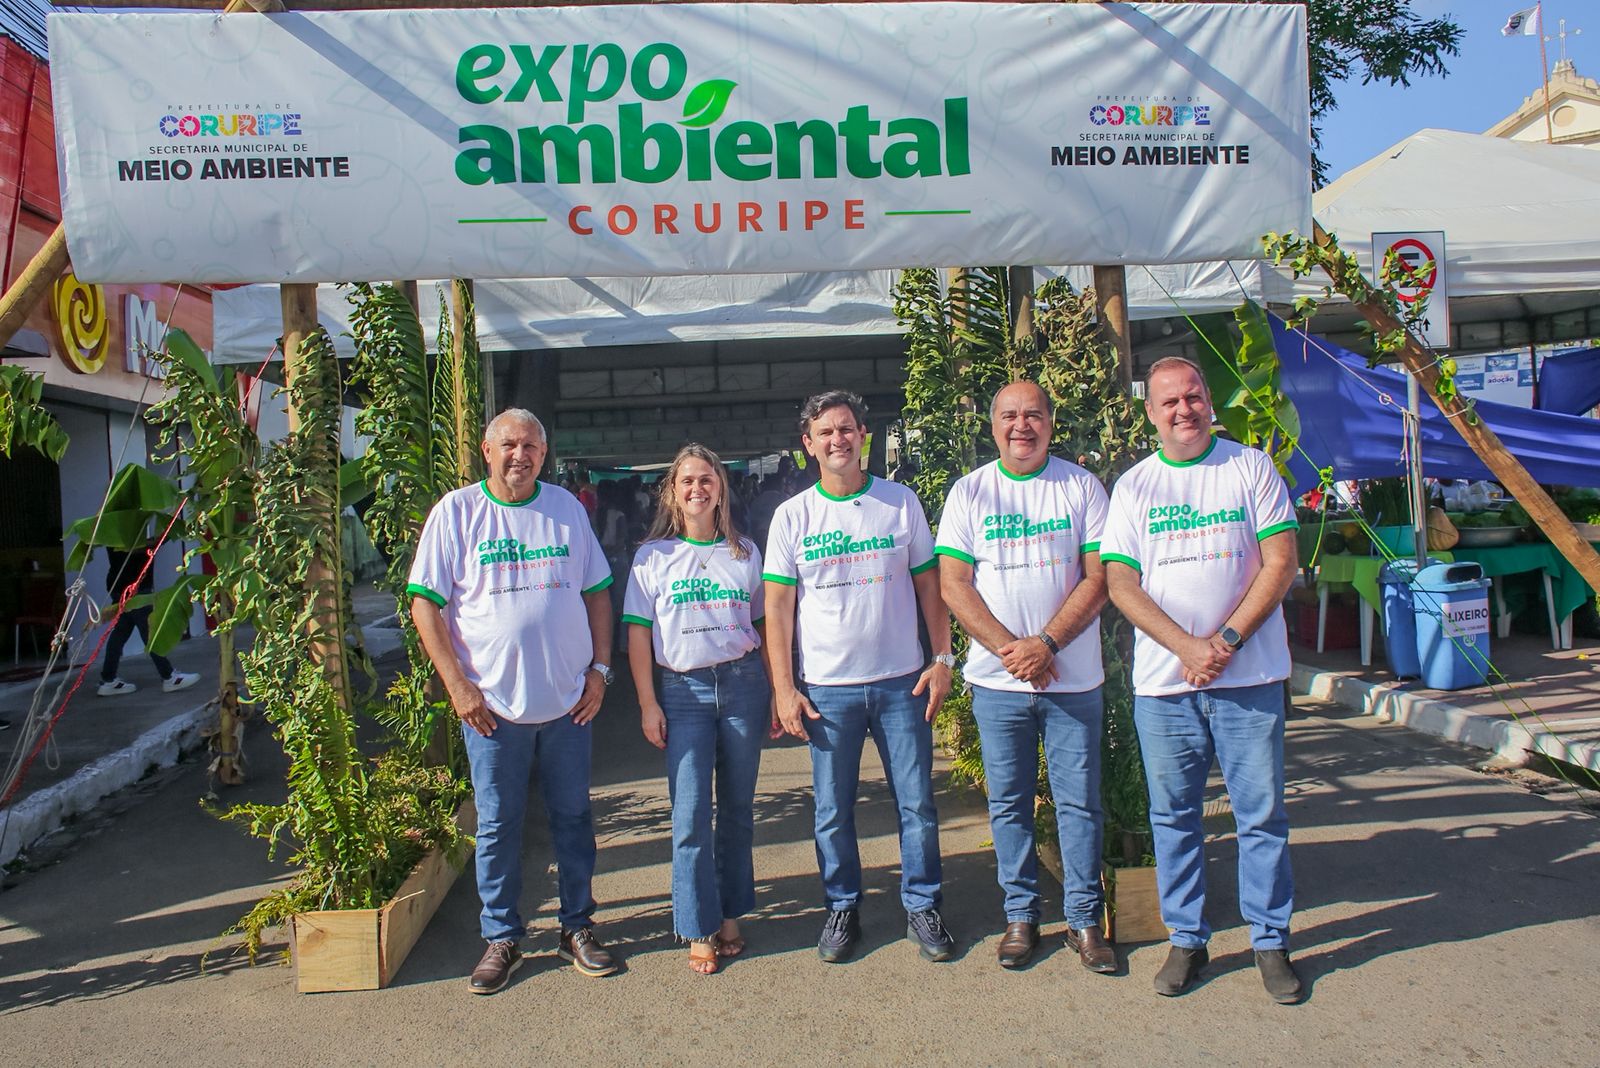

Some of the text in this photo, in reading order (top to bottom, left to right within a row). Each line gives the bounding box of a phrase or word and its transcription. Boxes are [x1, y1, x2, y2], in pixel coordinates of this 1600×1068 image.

[455, 42, 688, 125] expo
[167, 103, 262, 111] PREFEITURA
[1089, 105, 1211, 126] CORURIPE
[159, 113, 302, 137] CORURIPE
[454, 97, 972, 186] ambiental
[1079, 133, 1215, 142] SECRETARIA MUNICIPAL DE
[149, 143, 308, 155] SECRETARIA MUNICIPAL DE
[1051, 145, 1250, 166] MEIO AMBIENTE
[118, 156, 350, 181] MEIO AMBIENTE
[568, 199, 866, 235] CORURIPE
[1149, 504, 1191, 519] expo
[984, 513, 1023, 528] expo
[985, 514, 1072, 541] ambiental
[1149, 506, 1245, 535] ambiental
[803, 530, 844, 547] expo
[1169, 526, 1227, 541] CORURIPE
[478, 538, 519, 552] expo
[804, 534, 895, 561] ambiental
[480, 545, 570, 566] ambiental
[823, 552, 879, 567] CORURIPE
[1170, 556, 1197, 565] AMBIENTE
[500, 560, 555, 572] CORURIPE
[503, 586, 530, 594] AMBIENTE
[671, 577, 711, 591] expo
[672, 587, 750, 605] ambienta
[692, 602, 742, 611] CORURPE
[1448, 608, 1488, 623] LIXEIRO
